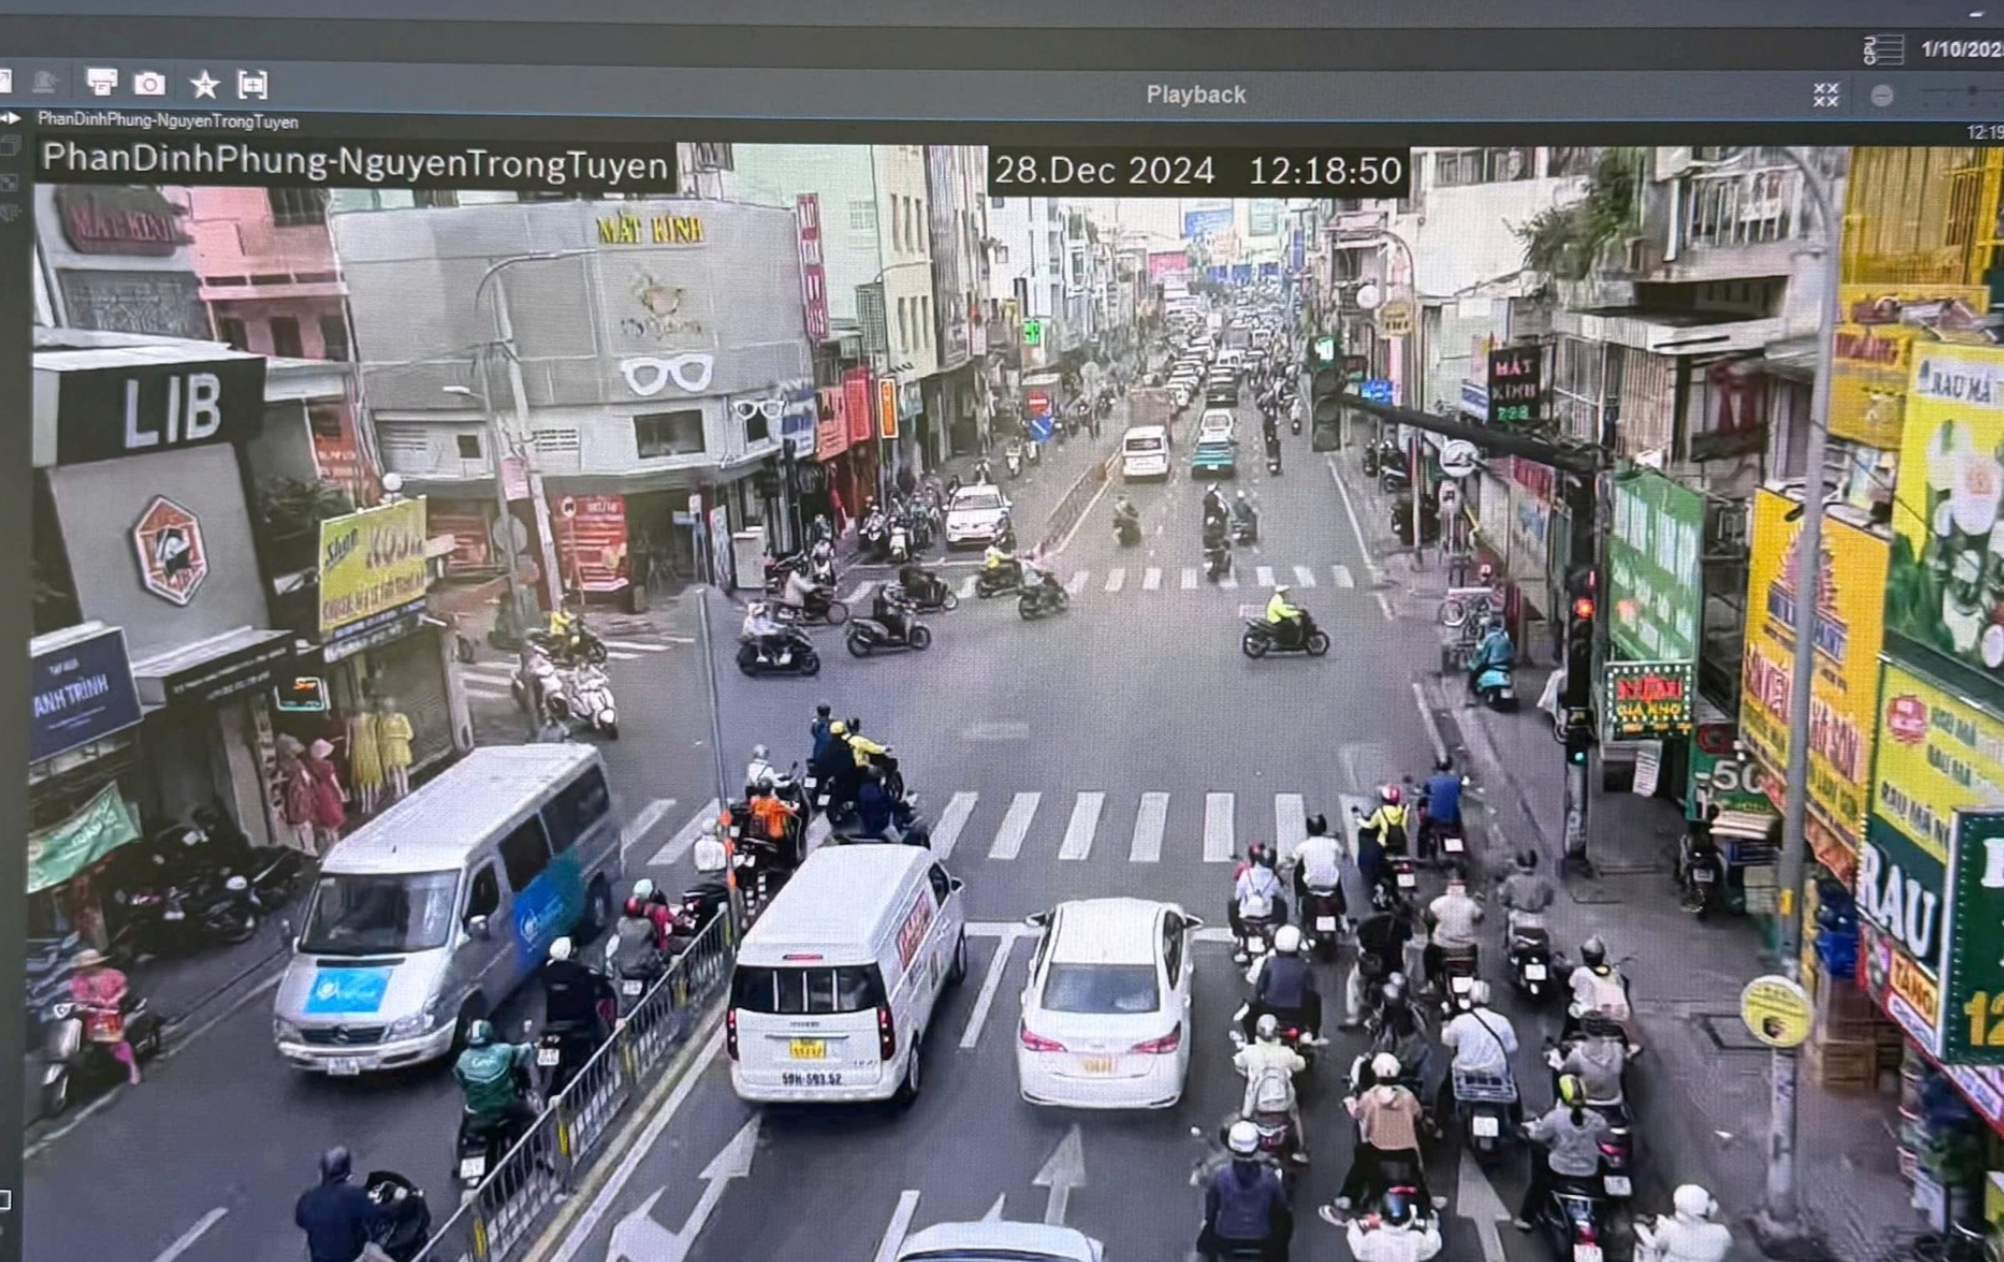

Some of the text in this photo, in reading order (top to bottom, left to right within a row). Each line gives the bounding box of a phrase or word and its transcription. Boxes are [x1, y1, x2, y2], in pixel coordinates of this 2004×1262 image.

[1863, 36, 1876, 66] CPU
[1921, 40, 2004, 58] 1/10/202
[1146, 84, 1247, 107] Playback
[38, 111, 299, 131] PhanDinhPhung-NguyenTrongTuyen
[43, 141, 668, 186] PhanDinhPhung-NguyenTrongTuyen
[996, 155, 1402, 186] 28.Dec 2024 12:18:50
[124, 372, 221, 449] LIB
[34, 688, 67, 718] ANH
[1855, 840, 1937, 959] RAU
